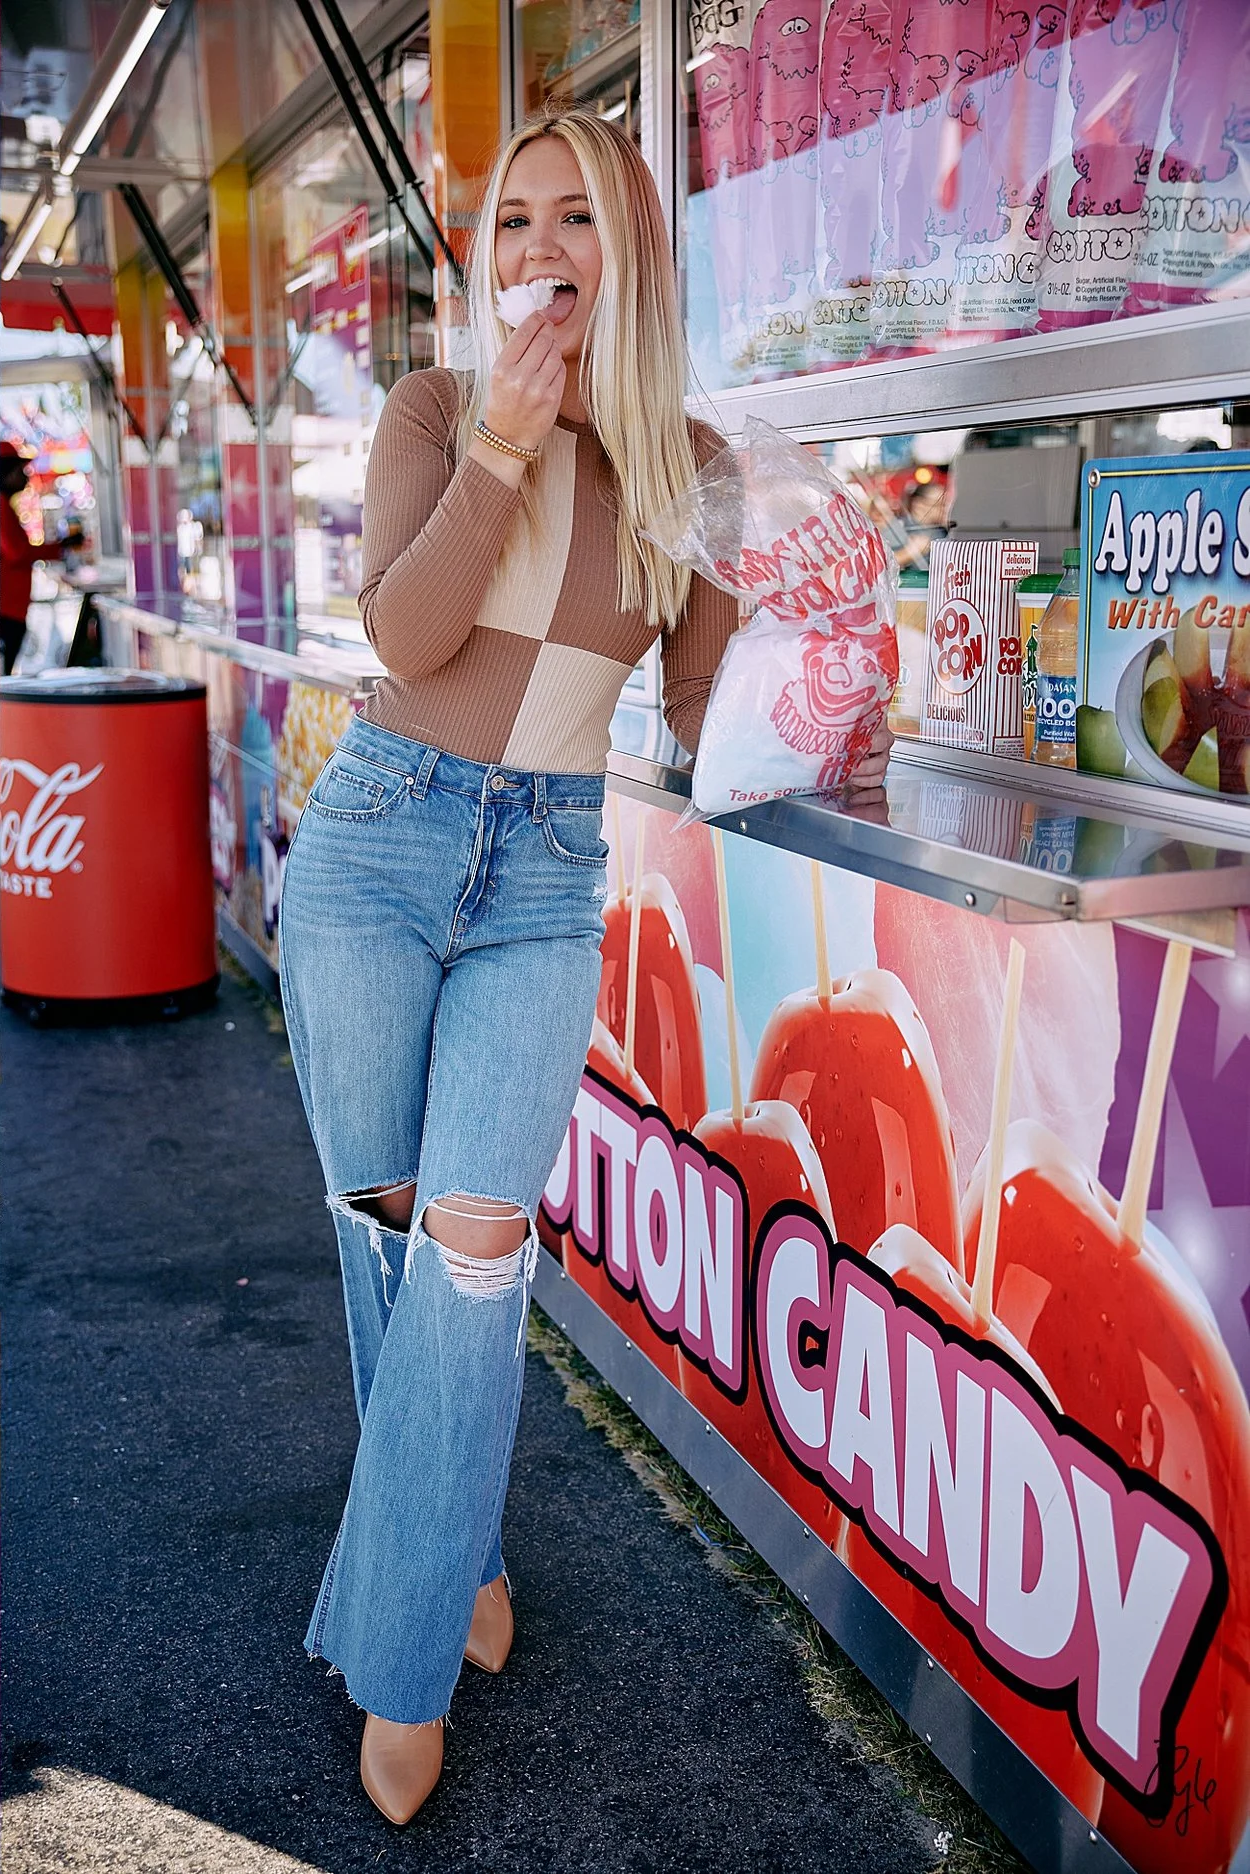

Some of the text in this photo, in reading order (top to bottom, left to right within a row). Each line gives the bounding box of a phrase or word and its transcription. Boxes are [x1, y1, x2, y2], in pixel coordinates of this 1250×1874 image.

[1006, 553, 1031, 566] delicious
[1094, 488, 1225, 595] Apple
[943, 562, 971, 599] fresh
[934, 607, 969, 651] POP
[1107, 595, 1180, 630] With
[937, 635, 982, 681] CORN
[729, 789, 768, 802] Take
[766, 1237, 1190, 1762] CANDY
